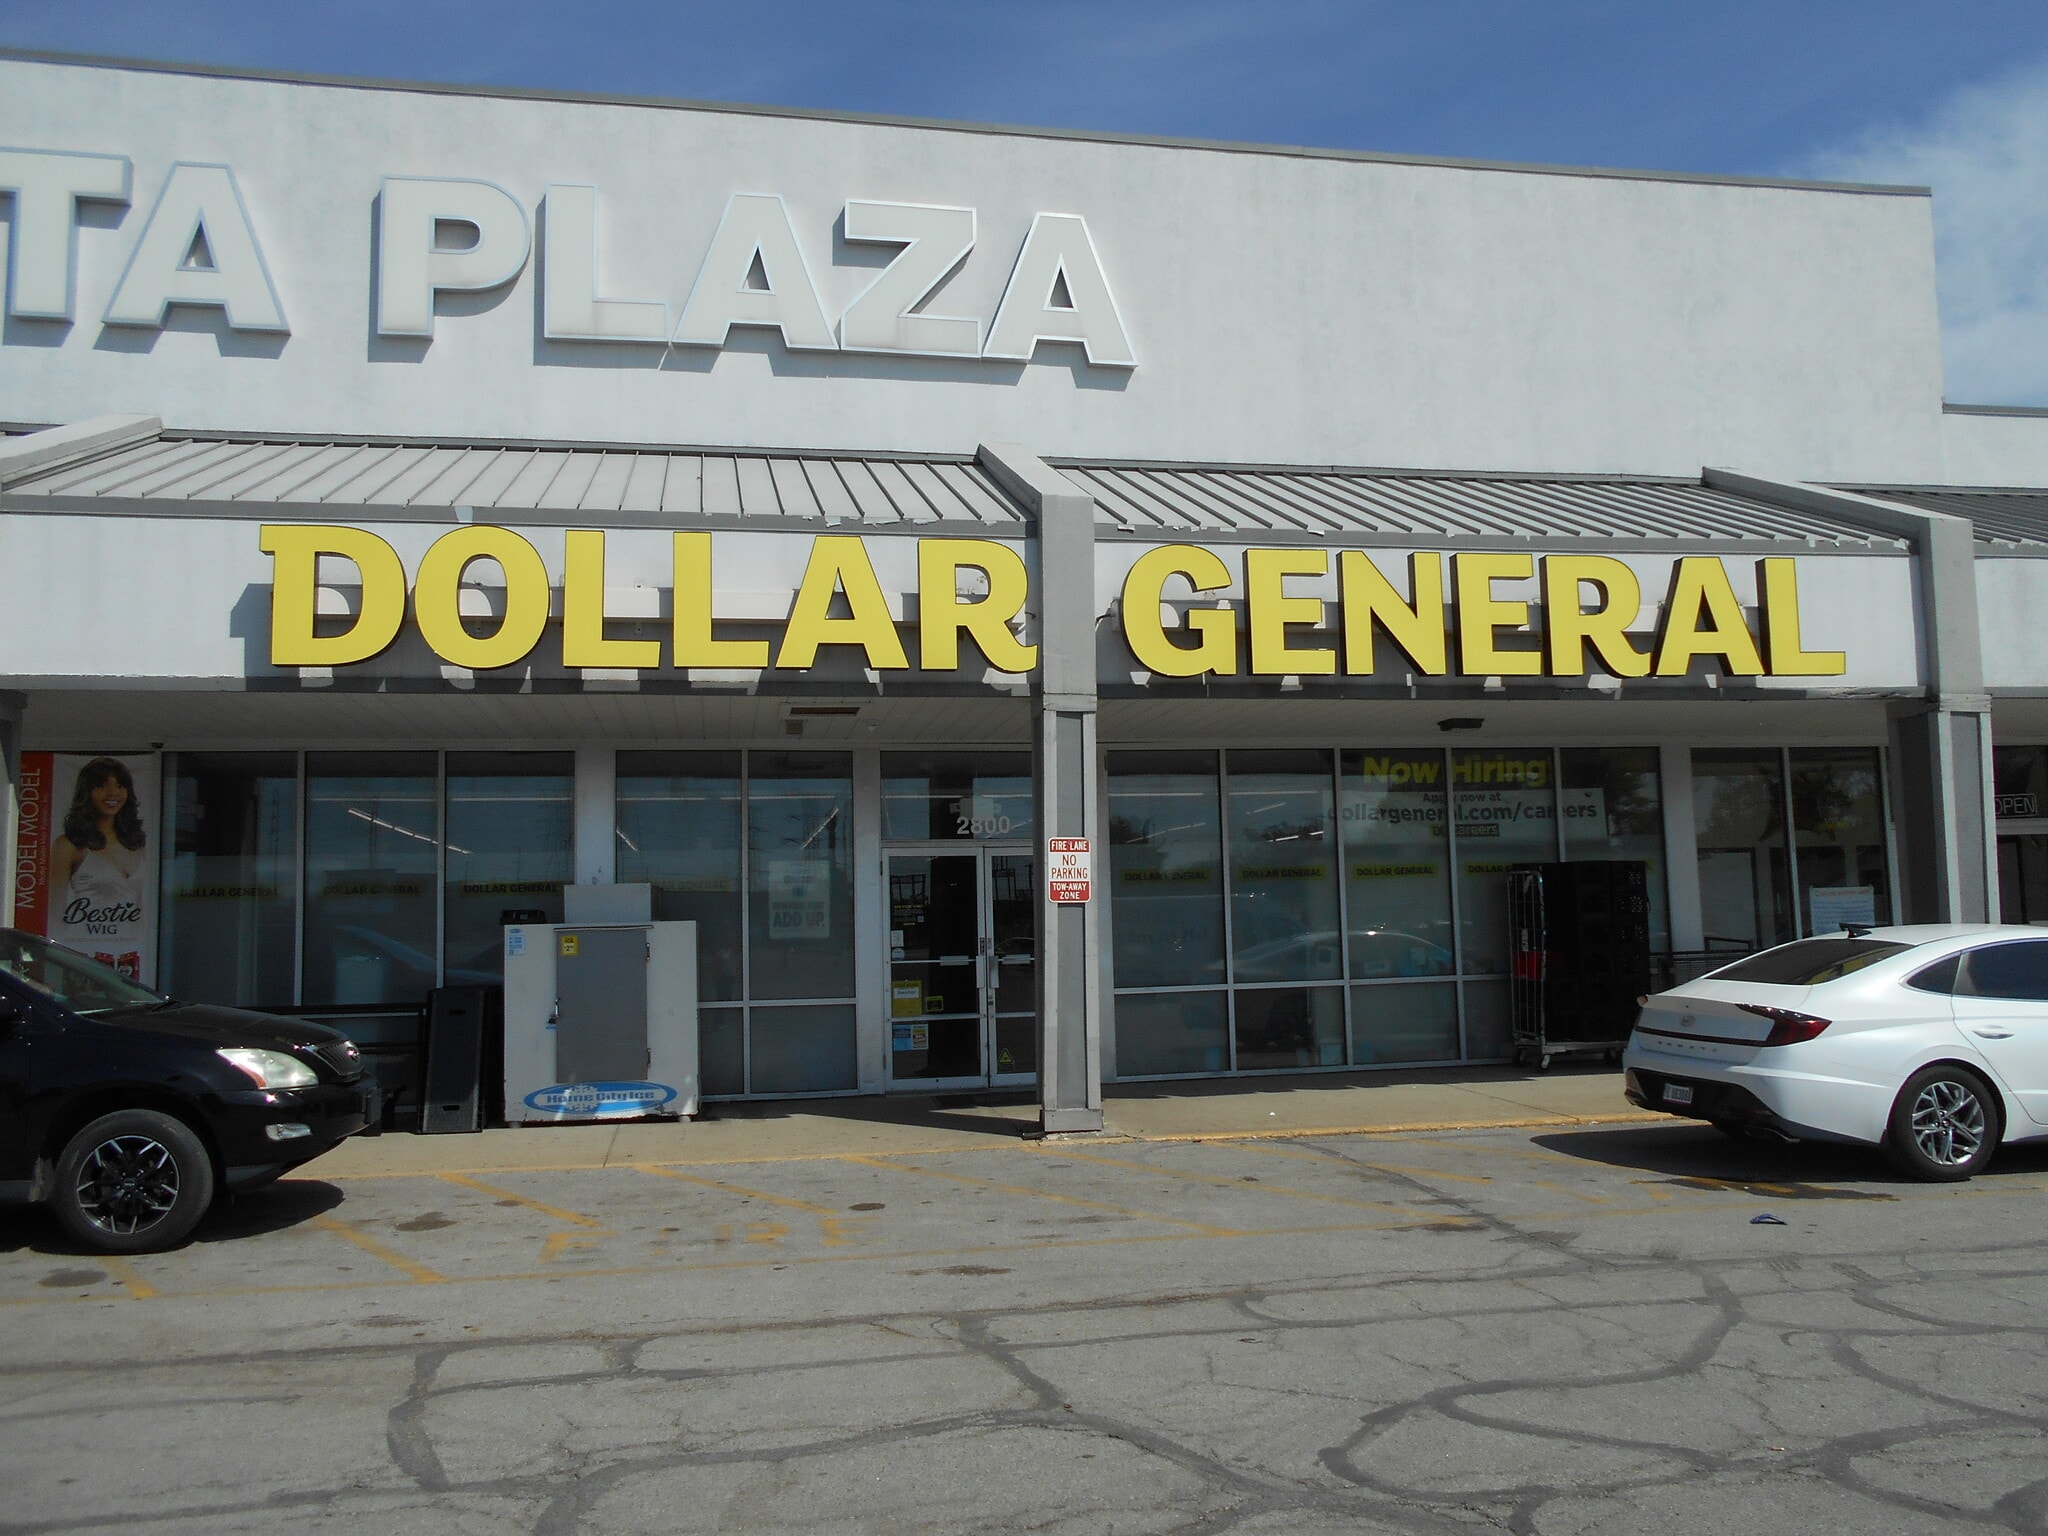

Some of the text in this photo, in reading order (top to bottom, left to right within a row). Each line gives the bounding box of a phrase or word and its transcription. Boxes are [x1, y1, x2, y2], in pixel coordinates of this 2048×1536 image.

[376, 174, 1139, 369] PLAZA
[260, 525, 1846, 678] DOLLAR GENERAL
[1363, 753, 1548, 788] Now Hiring
[1423, 792, 1501, 804] App now at
[956, 815, 1010, 835] 2800
[1455, 825, 1498, 835] areers
[16, 768, 40, 909] MODEL MODEL
[1051, 840, 1087, 850] FIRE LANE
[1062, 854, 1077, 866] NO
[1051, 867, 1088, 879] PARKING
[1242, 868, 1322, 878] DOLLAR GENERAL
[1356, 866, 1434, 876] DOLLAR GENERAL
[1468, 864, 1503, 873] DOLLAR
[1124, 872, 1163, 881] DOLLAR
[370, 884, 421, 894] GENERAL
[463, 883, 559, 893] DOLLAR GENERAL
[1053, 882, 1087, 891] TOW-AWAY
[228, 887, 278, 897] GENERAL
[1059, 891, 1080, 900] ZONE
[63, 897, 141, 924] Bestie
[86, 923, 117, 934] WIG
[547, 1090, 654, 1103] Home City Ice
